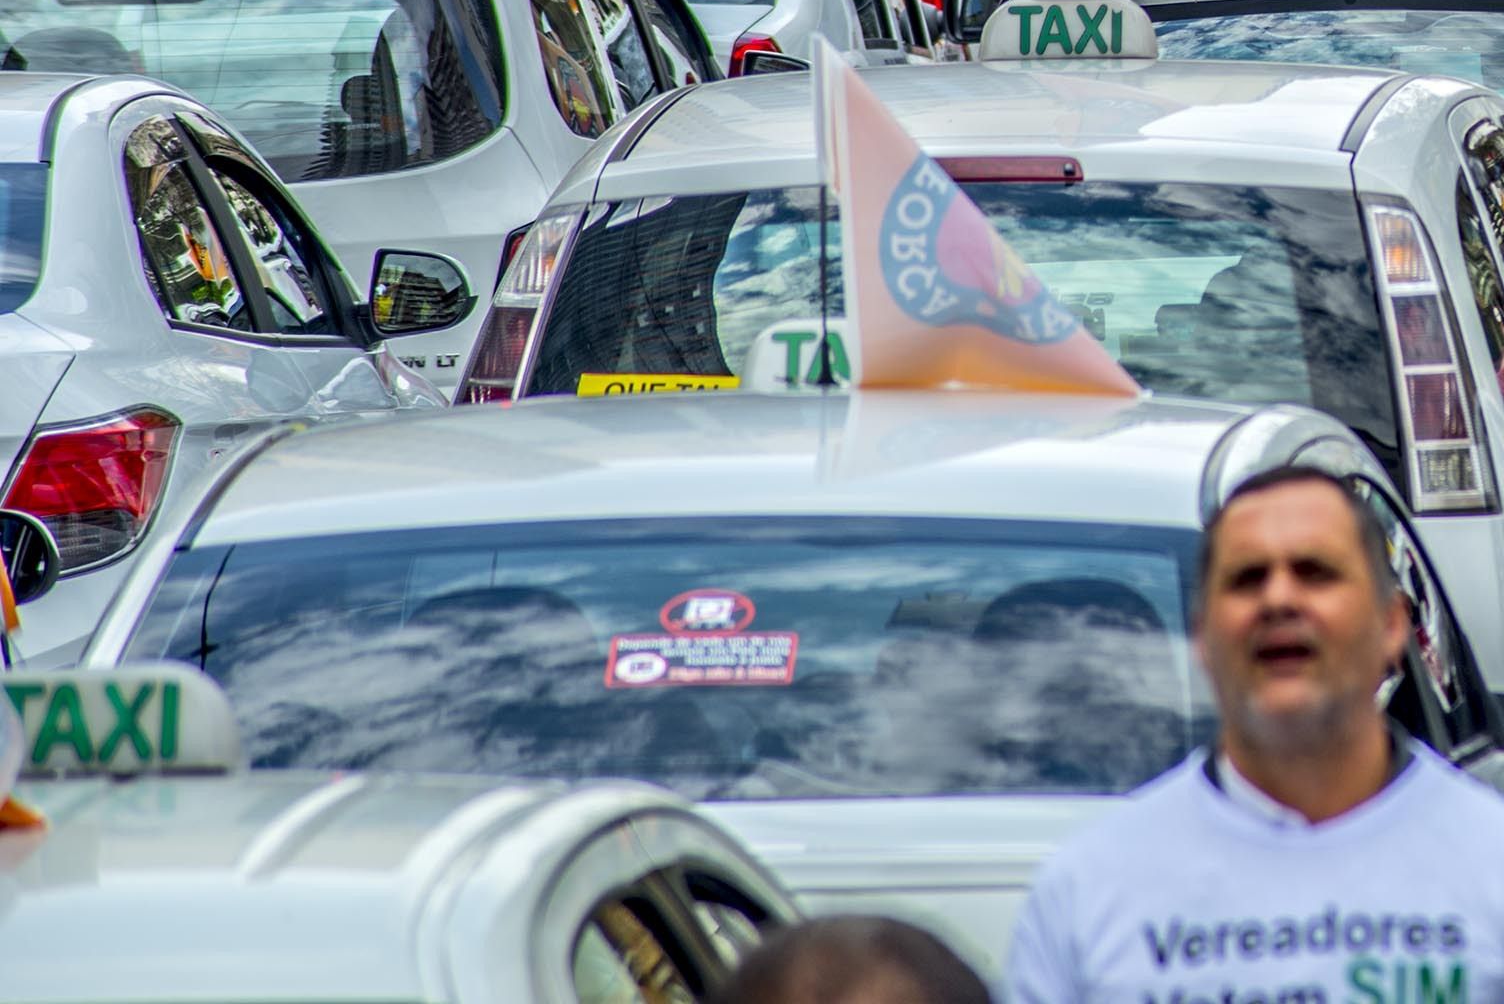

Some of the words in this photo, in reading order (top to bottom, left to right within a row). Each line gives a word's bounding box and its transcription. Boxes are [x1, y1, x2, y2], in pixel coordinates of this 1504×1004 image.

[1008, 4, 1123, 55] TAXI
[436, 353, 460, 368] LT
[771, 331, 851, 386] TA
[3, 680, 181, 765] TAXI
[1143, 904, 1467, 969] Vereadores
